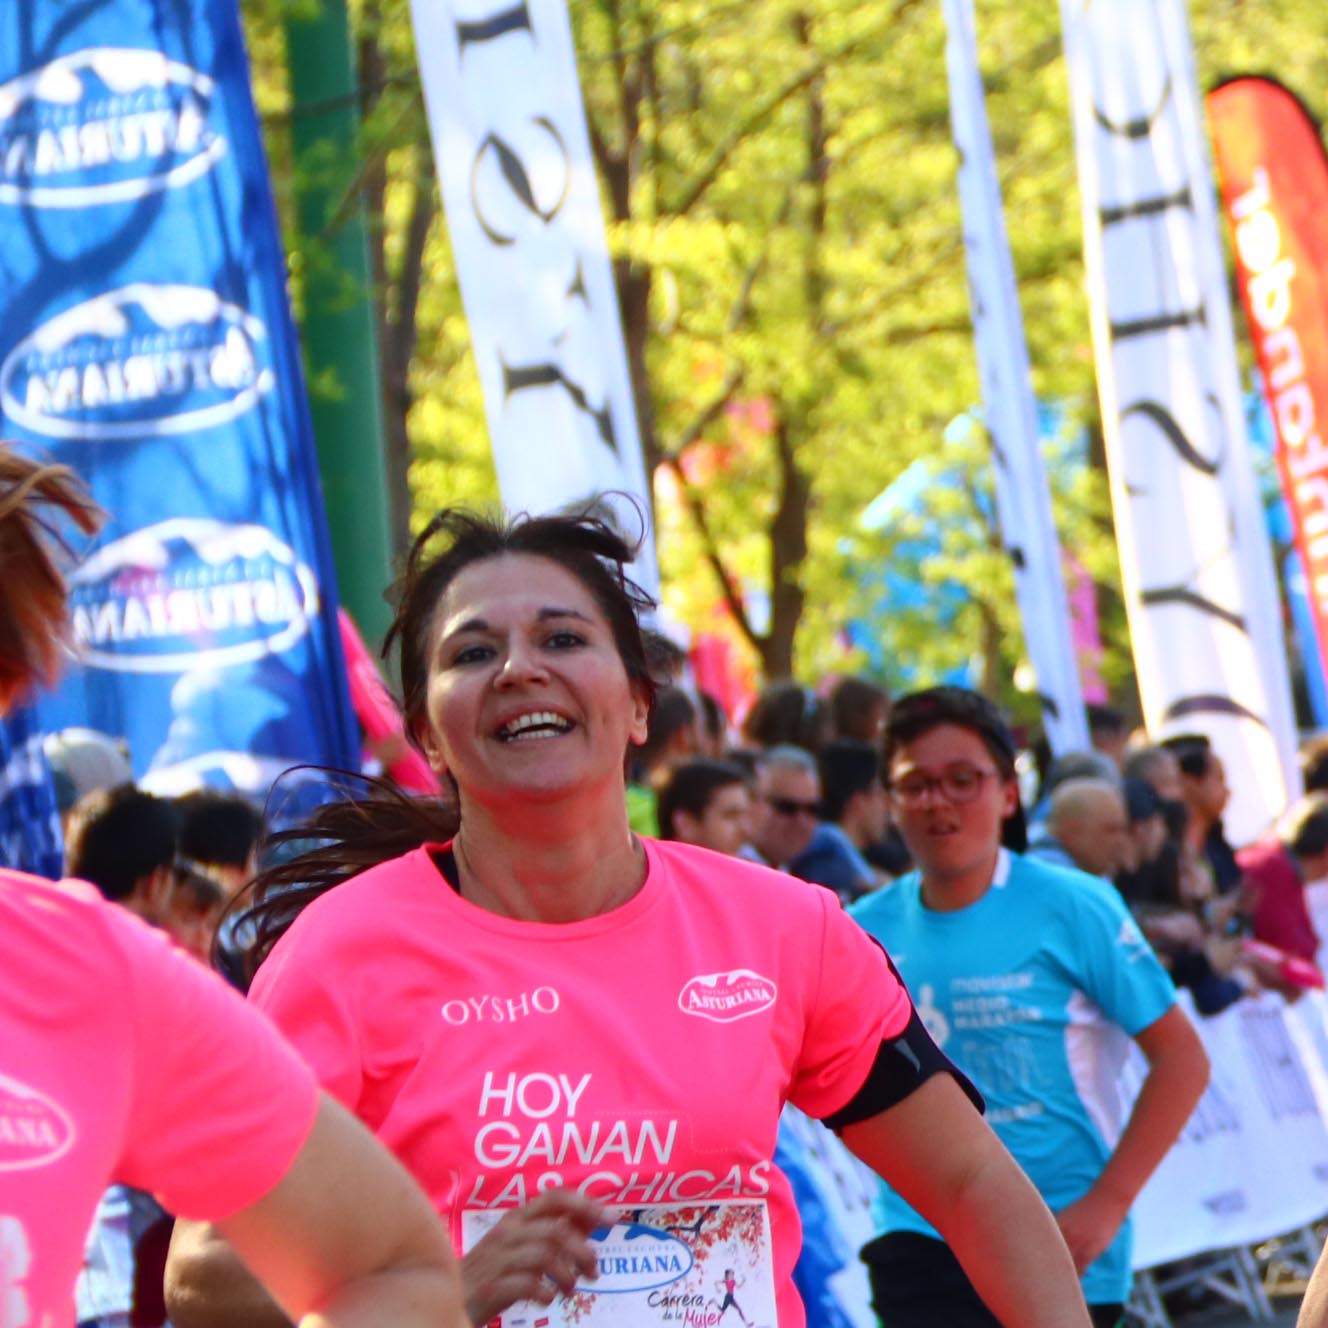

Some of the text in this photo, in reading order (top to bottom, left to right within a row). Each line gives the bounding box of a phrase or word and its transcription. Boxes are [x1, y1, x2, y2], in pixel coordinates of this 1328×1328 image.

[442, 986, 560, 1025] OYSHO
[478, 1071, 592, 1118] HOY
[474, 1120, 677, 1168] GANAN
[576, 1160, 770, 1203] CHICAS
[598, 1254, 683, 1275] URIANA
[646, 1290, 704, 1308] Carrera
